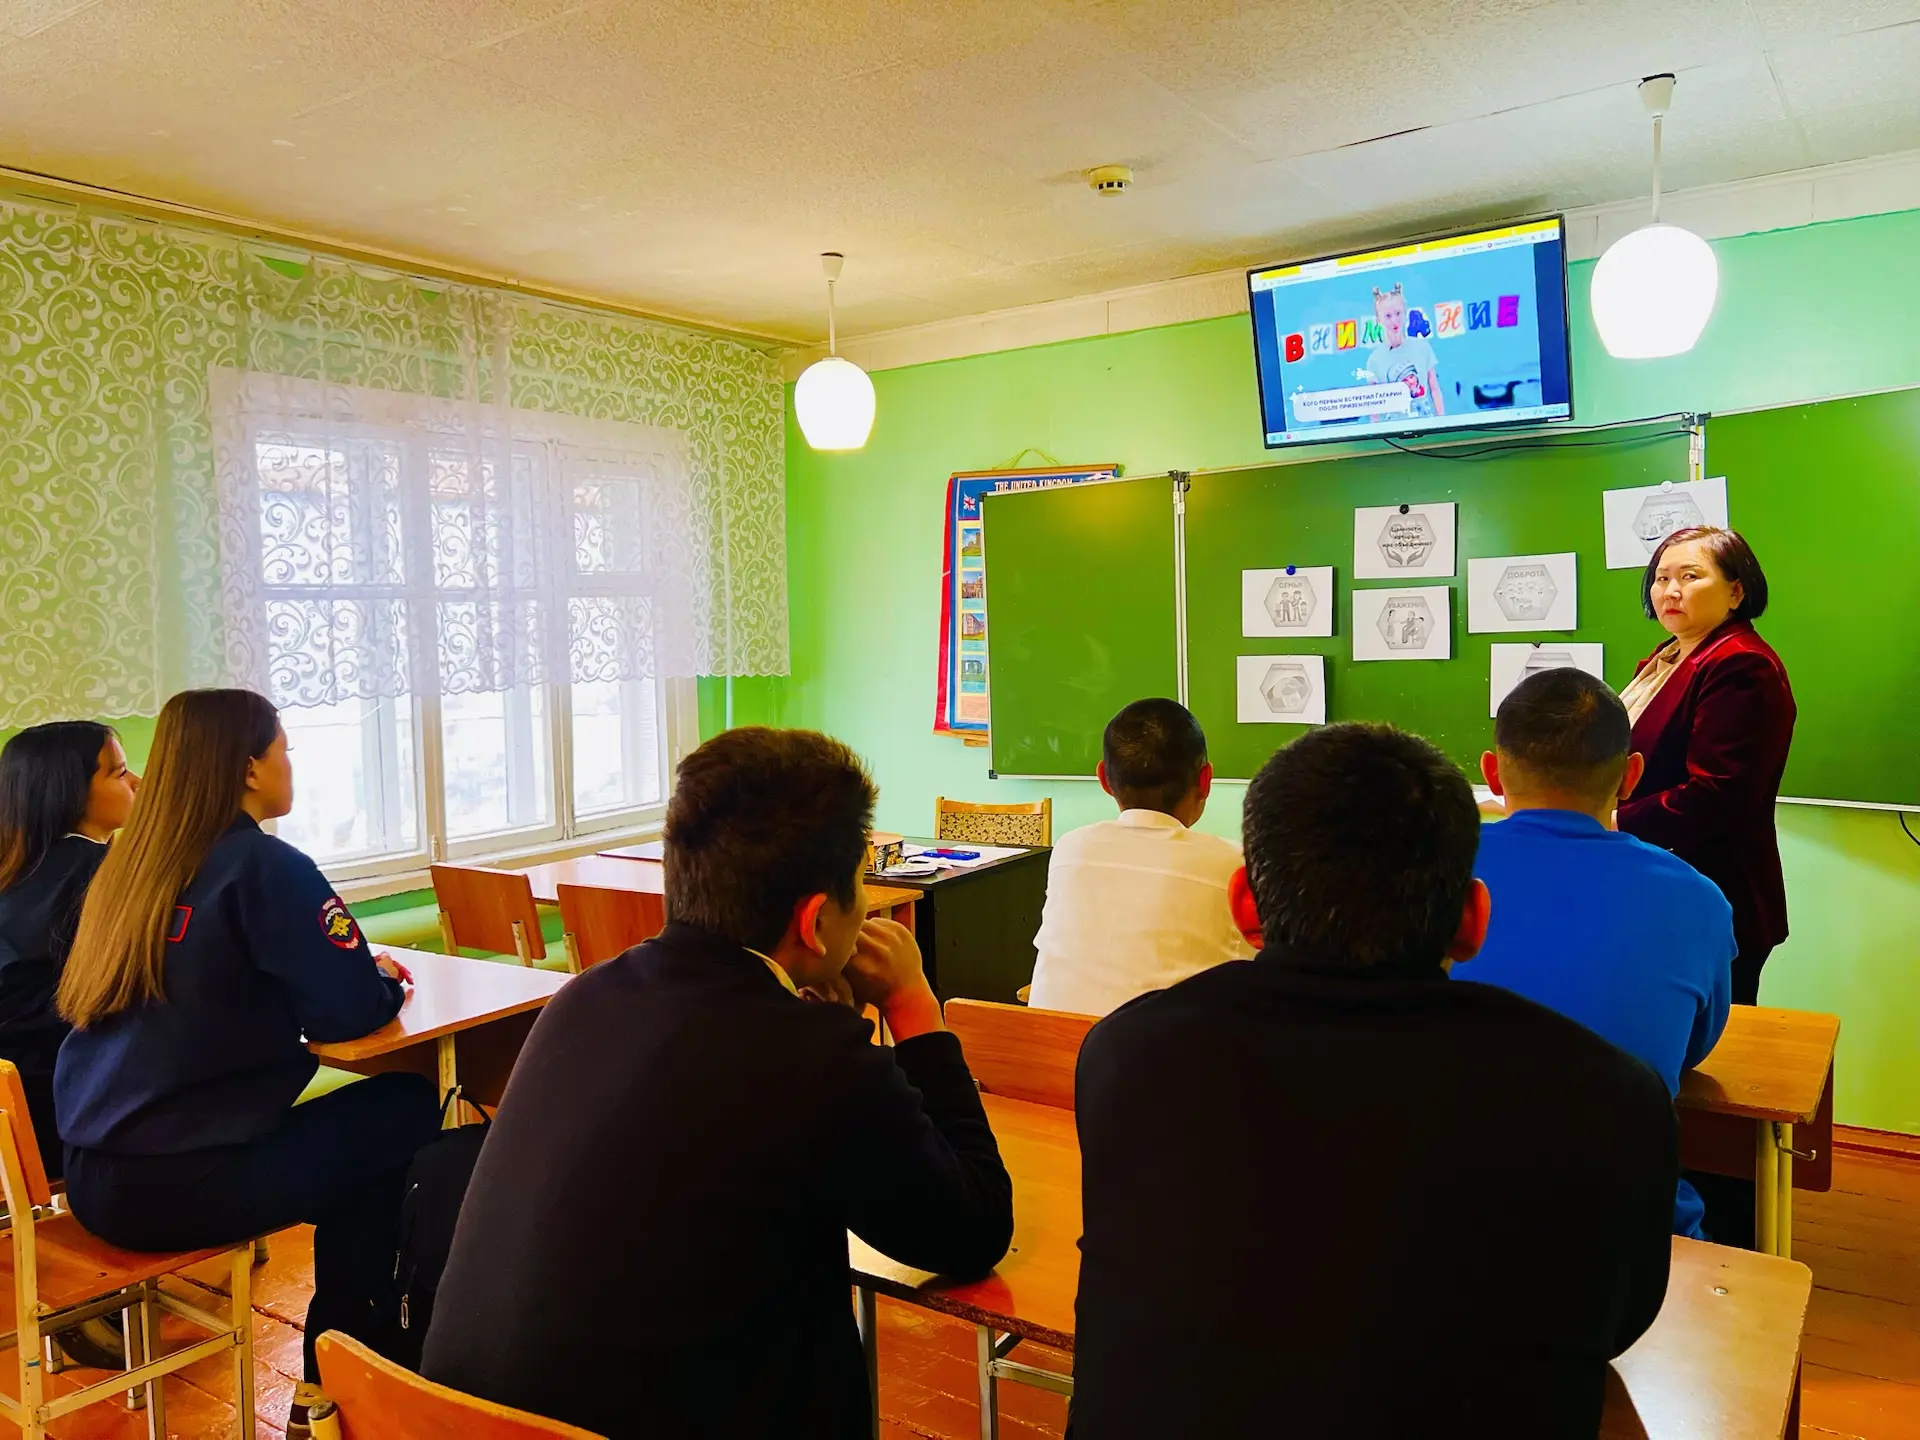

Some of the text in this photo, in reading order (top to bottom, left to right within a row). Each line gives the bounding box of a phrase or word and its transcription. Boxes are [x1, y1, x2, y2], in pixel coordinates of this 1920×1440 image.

[1285, 296, 1519, 363] ВНИМАНИЕ
[1344, 394, 1375, 402] ВСТРЕТИЛ
[1375, 391, 1402, 399] ГАГАРИН
[995, 481, 1009, 492] THE
[1011, 480, 1037, 490] UNITED
[1507, 570, 1546, 579] ДОБРОТА
[1278, 581, 1303, 589] СЕМЬЯ
